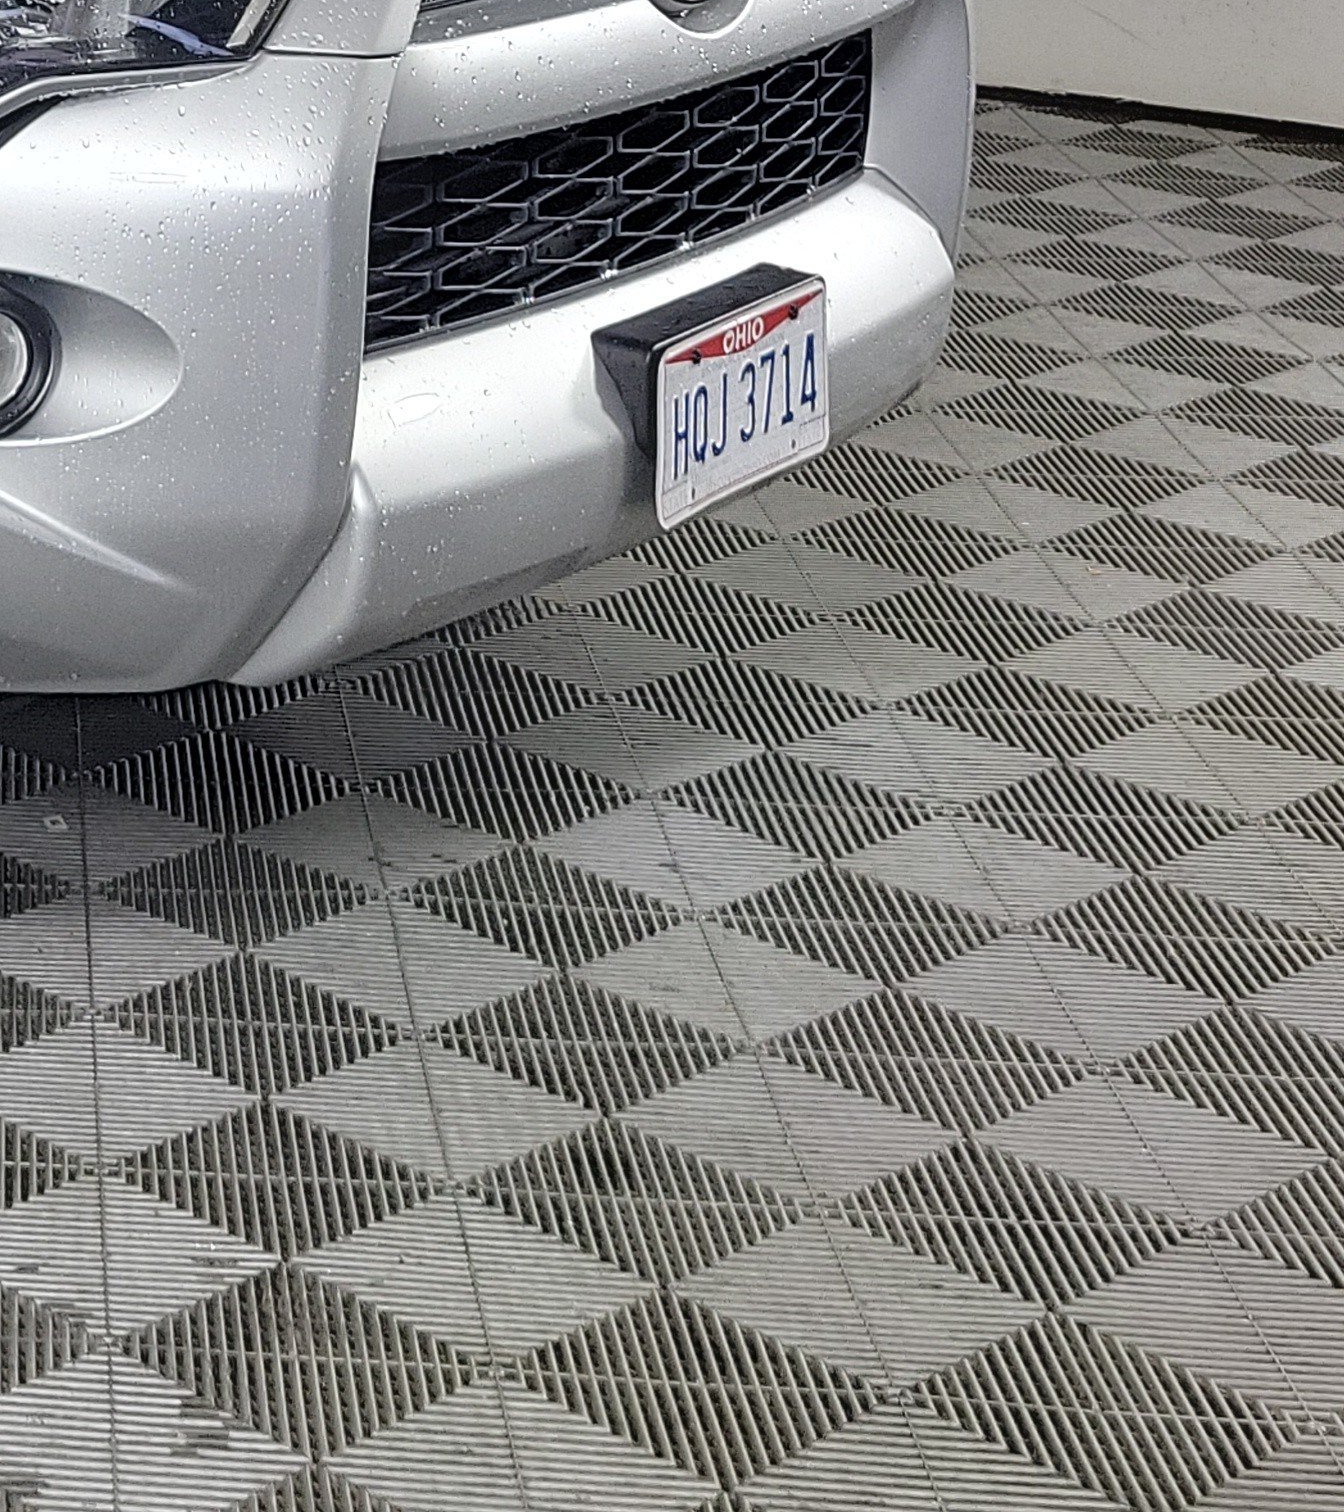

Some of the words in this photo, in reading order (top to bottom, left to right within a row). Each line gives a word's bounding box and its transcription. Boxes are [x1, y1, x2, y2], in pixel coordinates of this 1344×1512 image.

[722, 316, 765, 354] OHIO
[672, 371, 729, 481] HQJ
[739, 331, 818, 443] 3714
